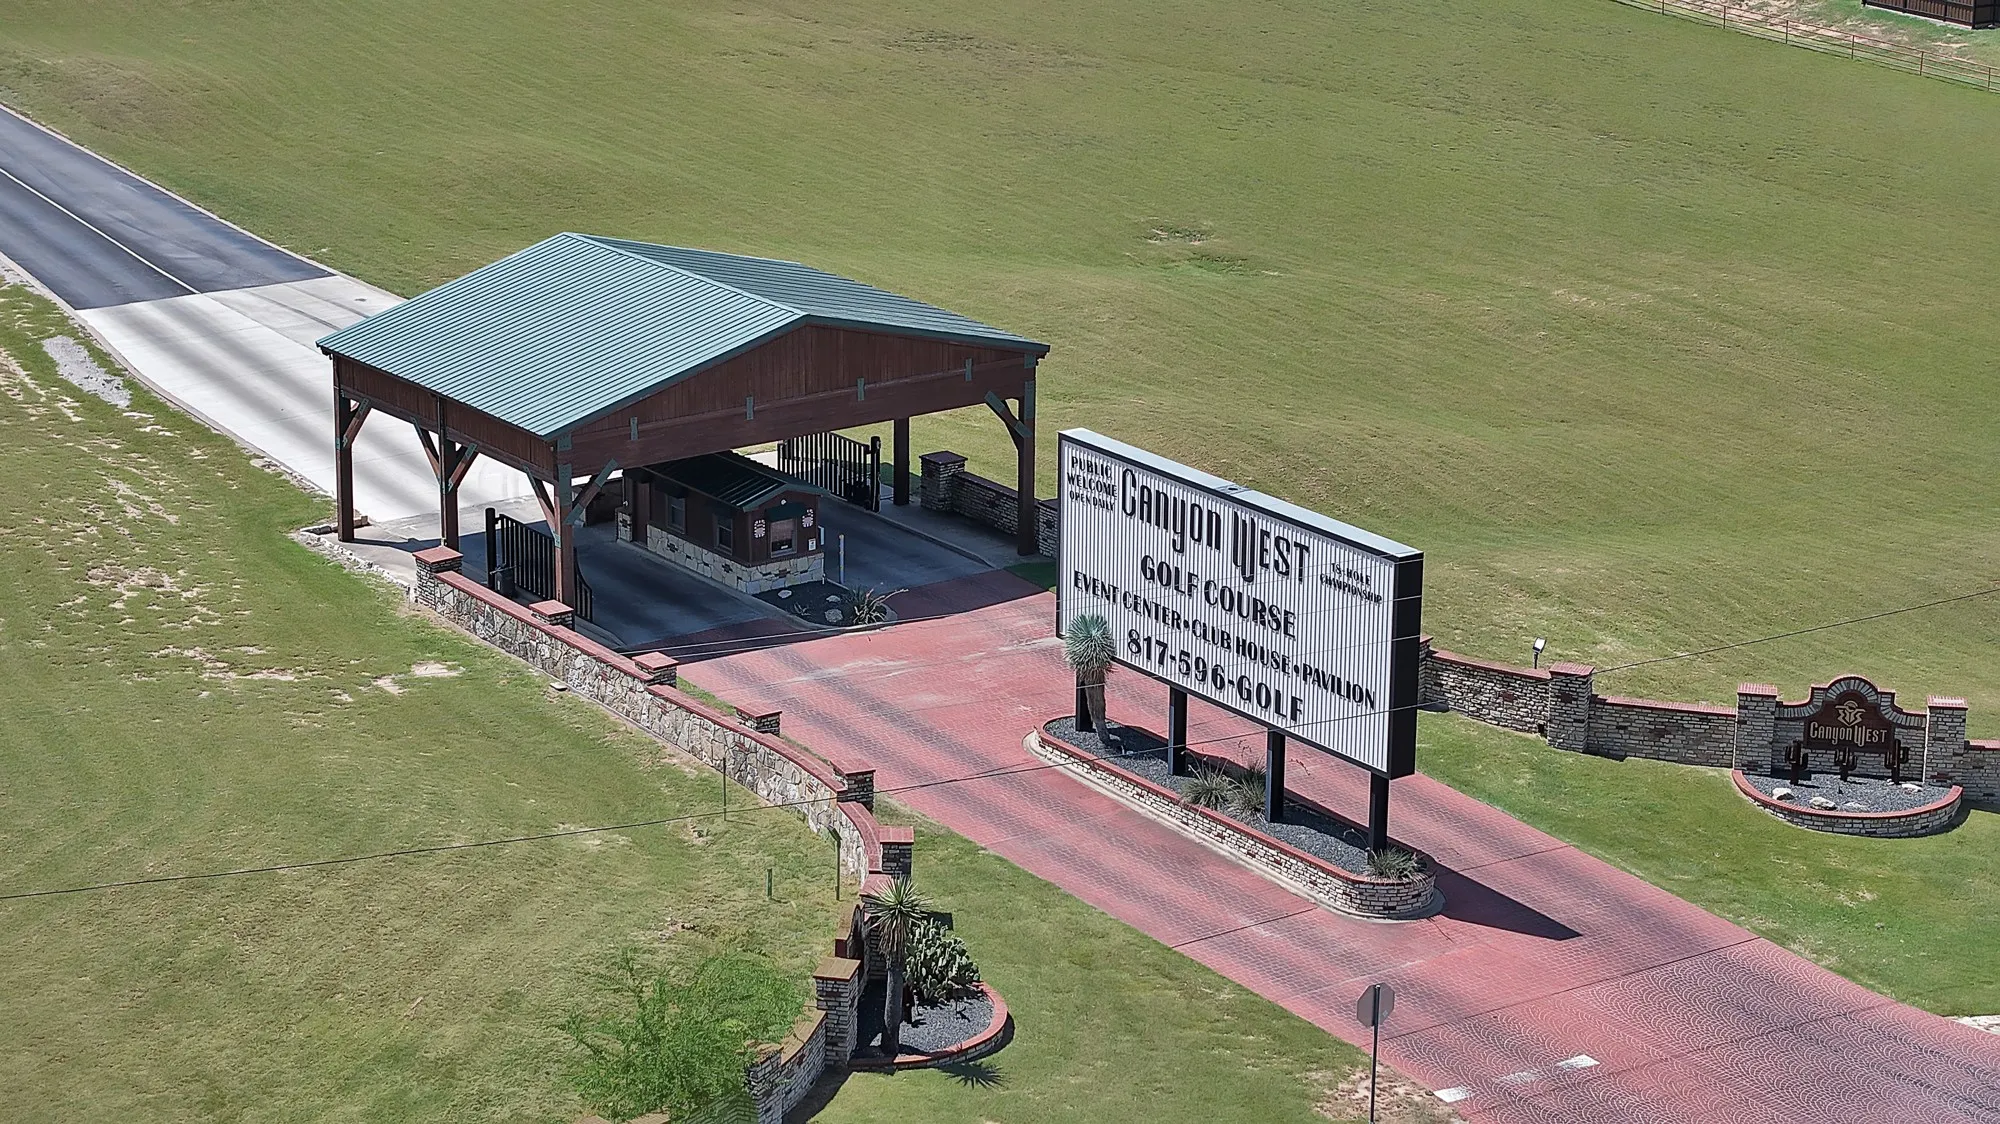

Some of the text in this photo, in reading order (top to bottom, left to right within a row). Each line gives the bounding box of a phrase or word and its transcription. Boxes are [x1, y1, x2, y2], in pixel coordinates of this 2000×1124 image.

[1071, 456, 1112, 479] PUBLIC
[1067, 472, 1117, 498] WELCOME
[1069, 490, 1115, 512] OPEN DAILY
[1232, 510, 1310, 583] WEST
[1319, 573, 1383, 604] CHAMPIONSHIP
[1331, 562, 1372, 588] 18-HOLE
[1141, 554, 1297, 640] GOLF COURSE
[1074, 570, 1119, 604] EVENT
[1302, 662, 1376, 711] PAVILION
[1127, 628, 1303, 723] 817-596-GOLF
